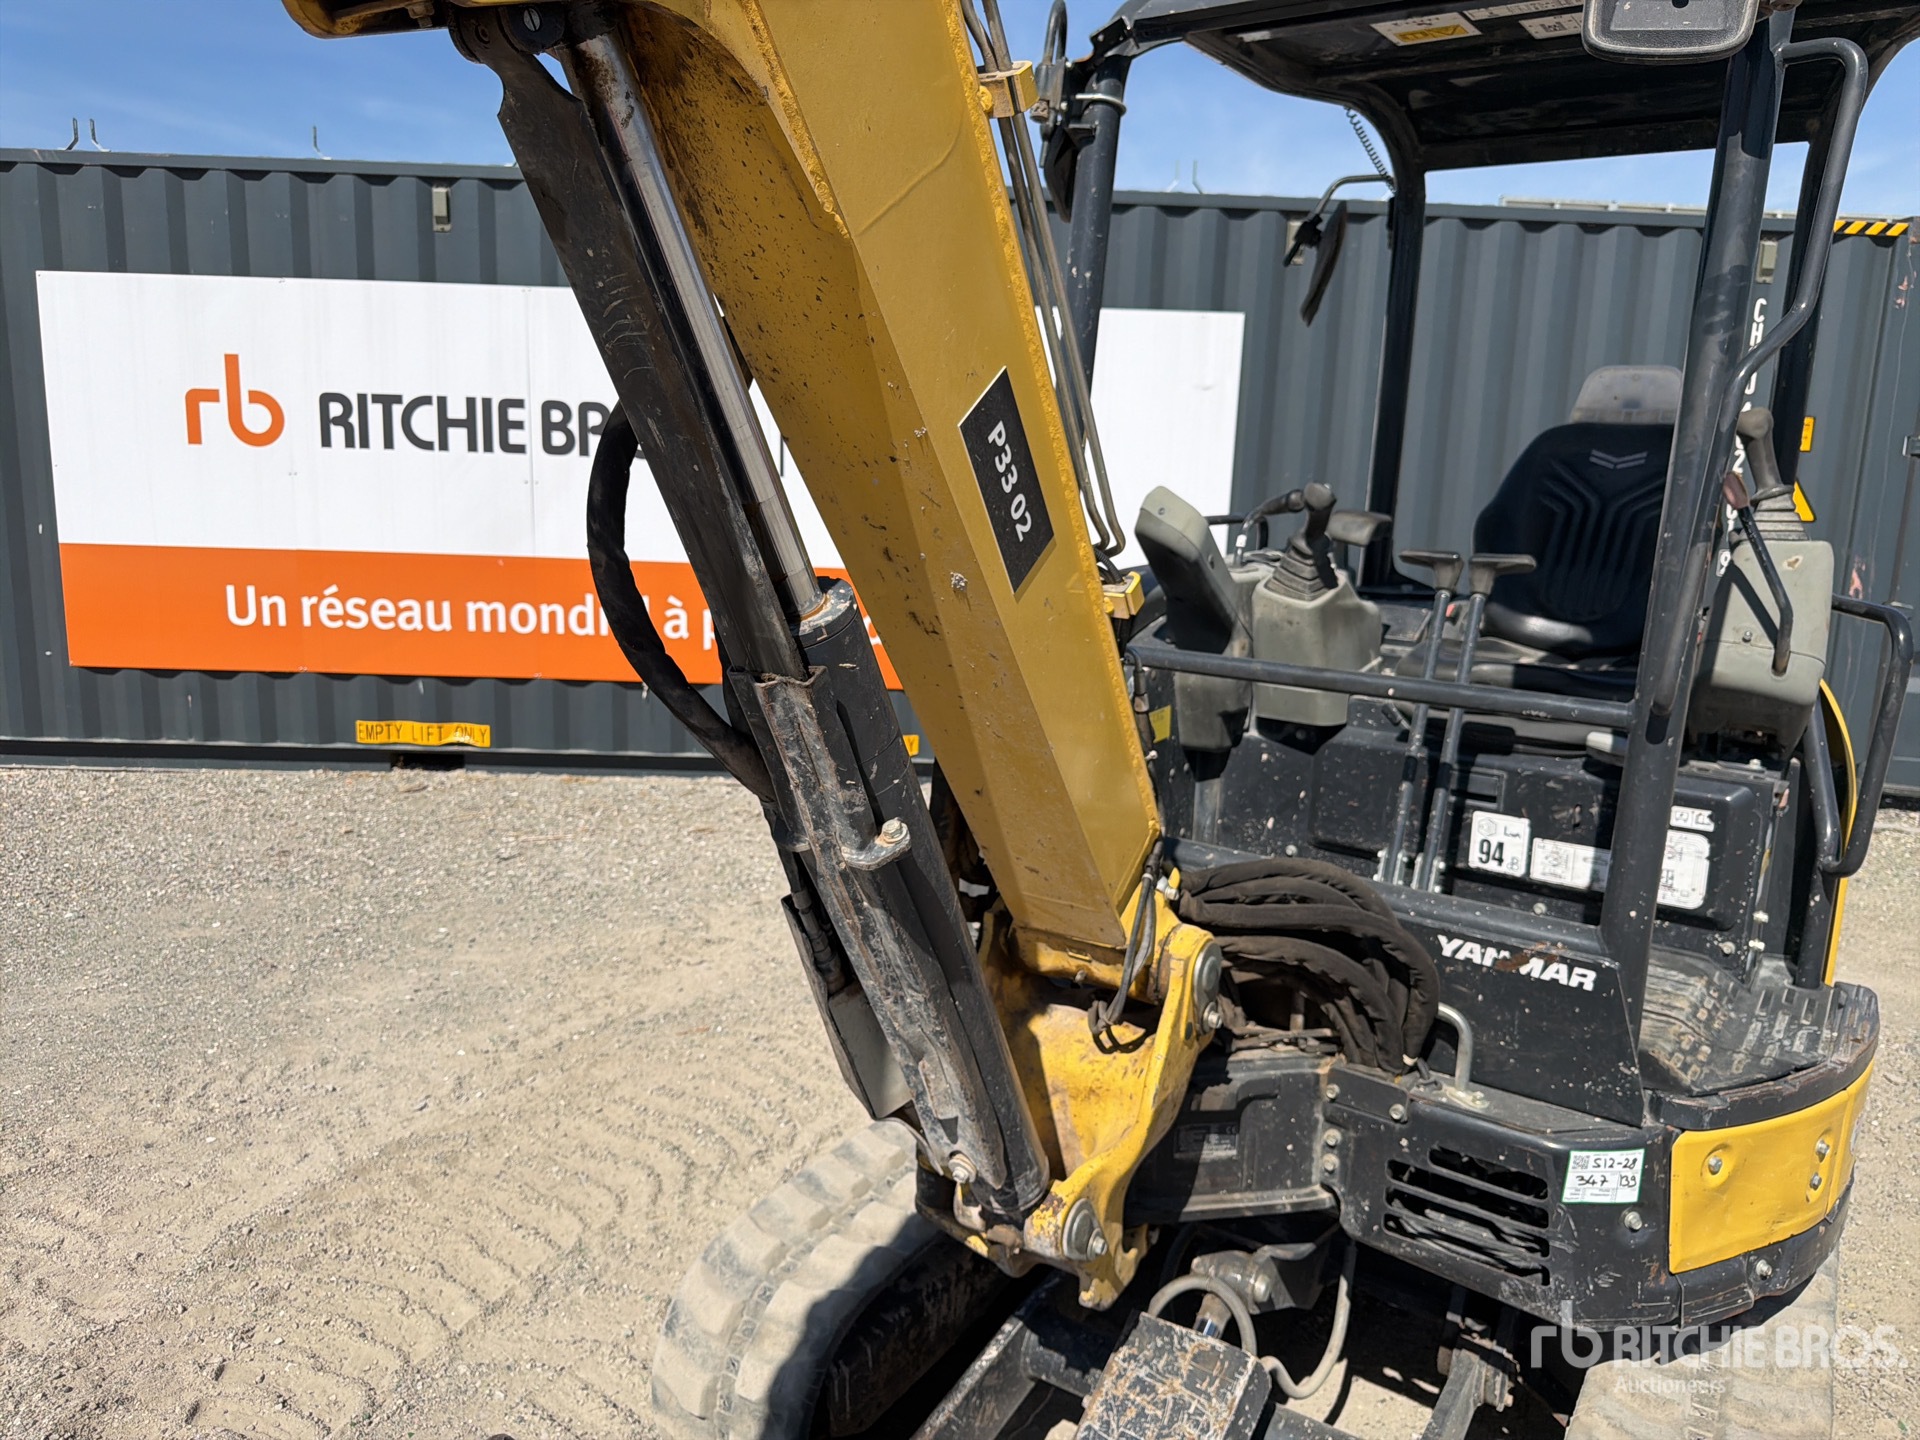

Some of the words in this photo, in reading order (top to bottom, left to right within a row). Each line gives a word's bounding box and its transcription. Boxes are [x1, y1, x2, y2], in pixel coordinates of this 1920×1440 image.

[318, 391, 527, 455] RITCHIE
[225, 585, 287, 626] Un
[302, 584, 452, 632] réseau
[662, 595, 690, 640] à
[358, 723, 402, 741] EMPTY
[412, 724, 444, 742] LIFT
[455, 725, 488, 744] ONLY
[1478, 838, 1504, 867] 94
[1576, 1174, 1609, 1187] 347
